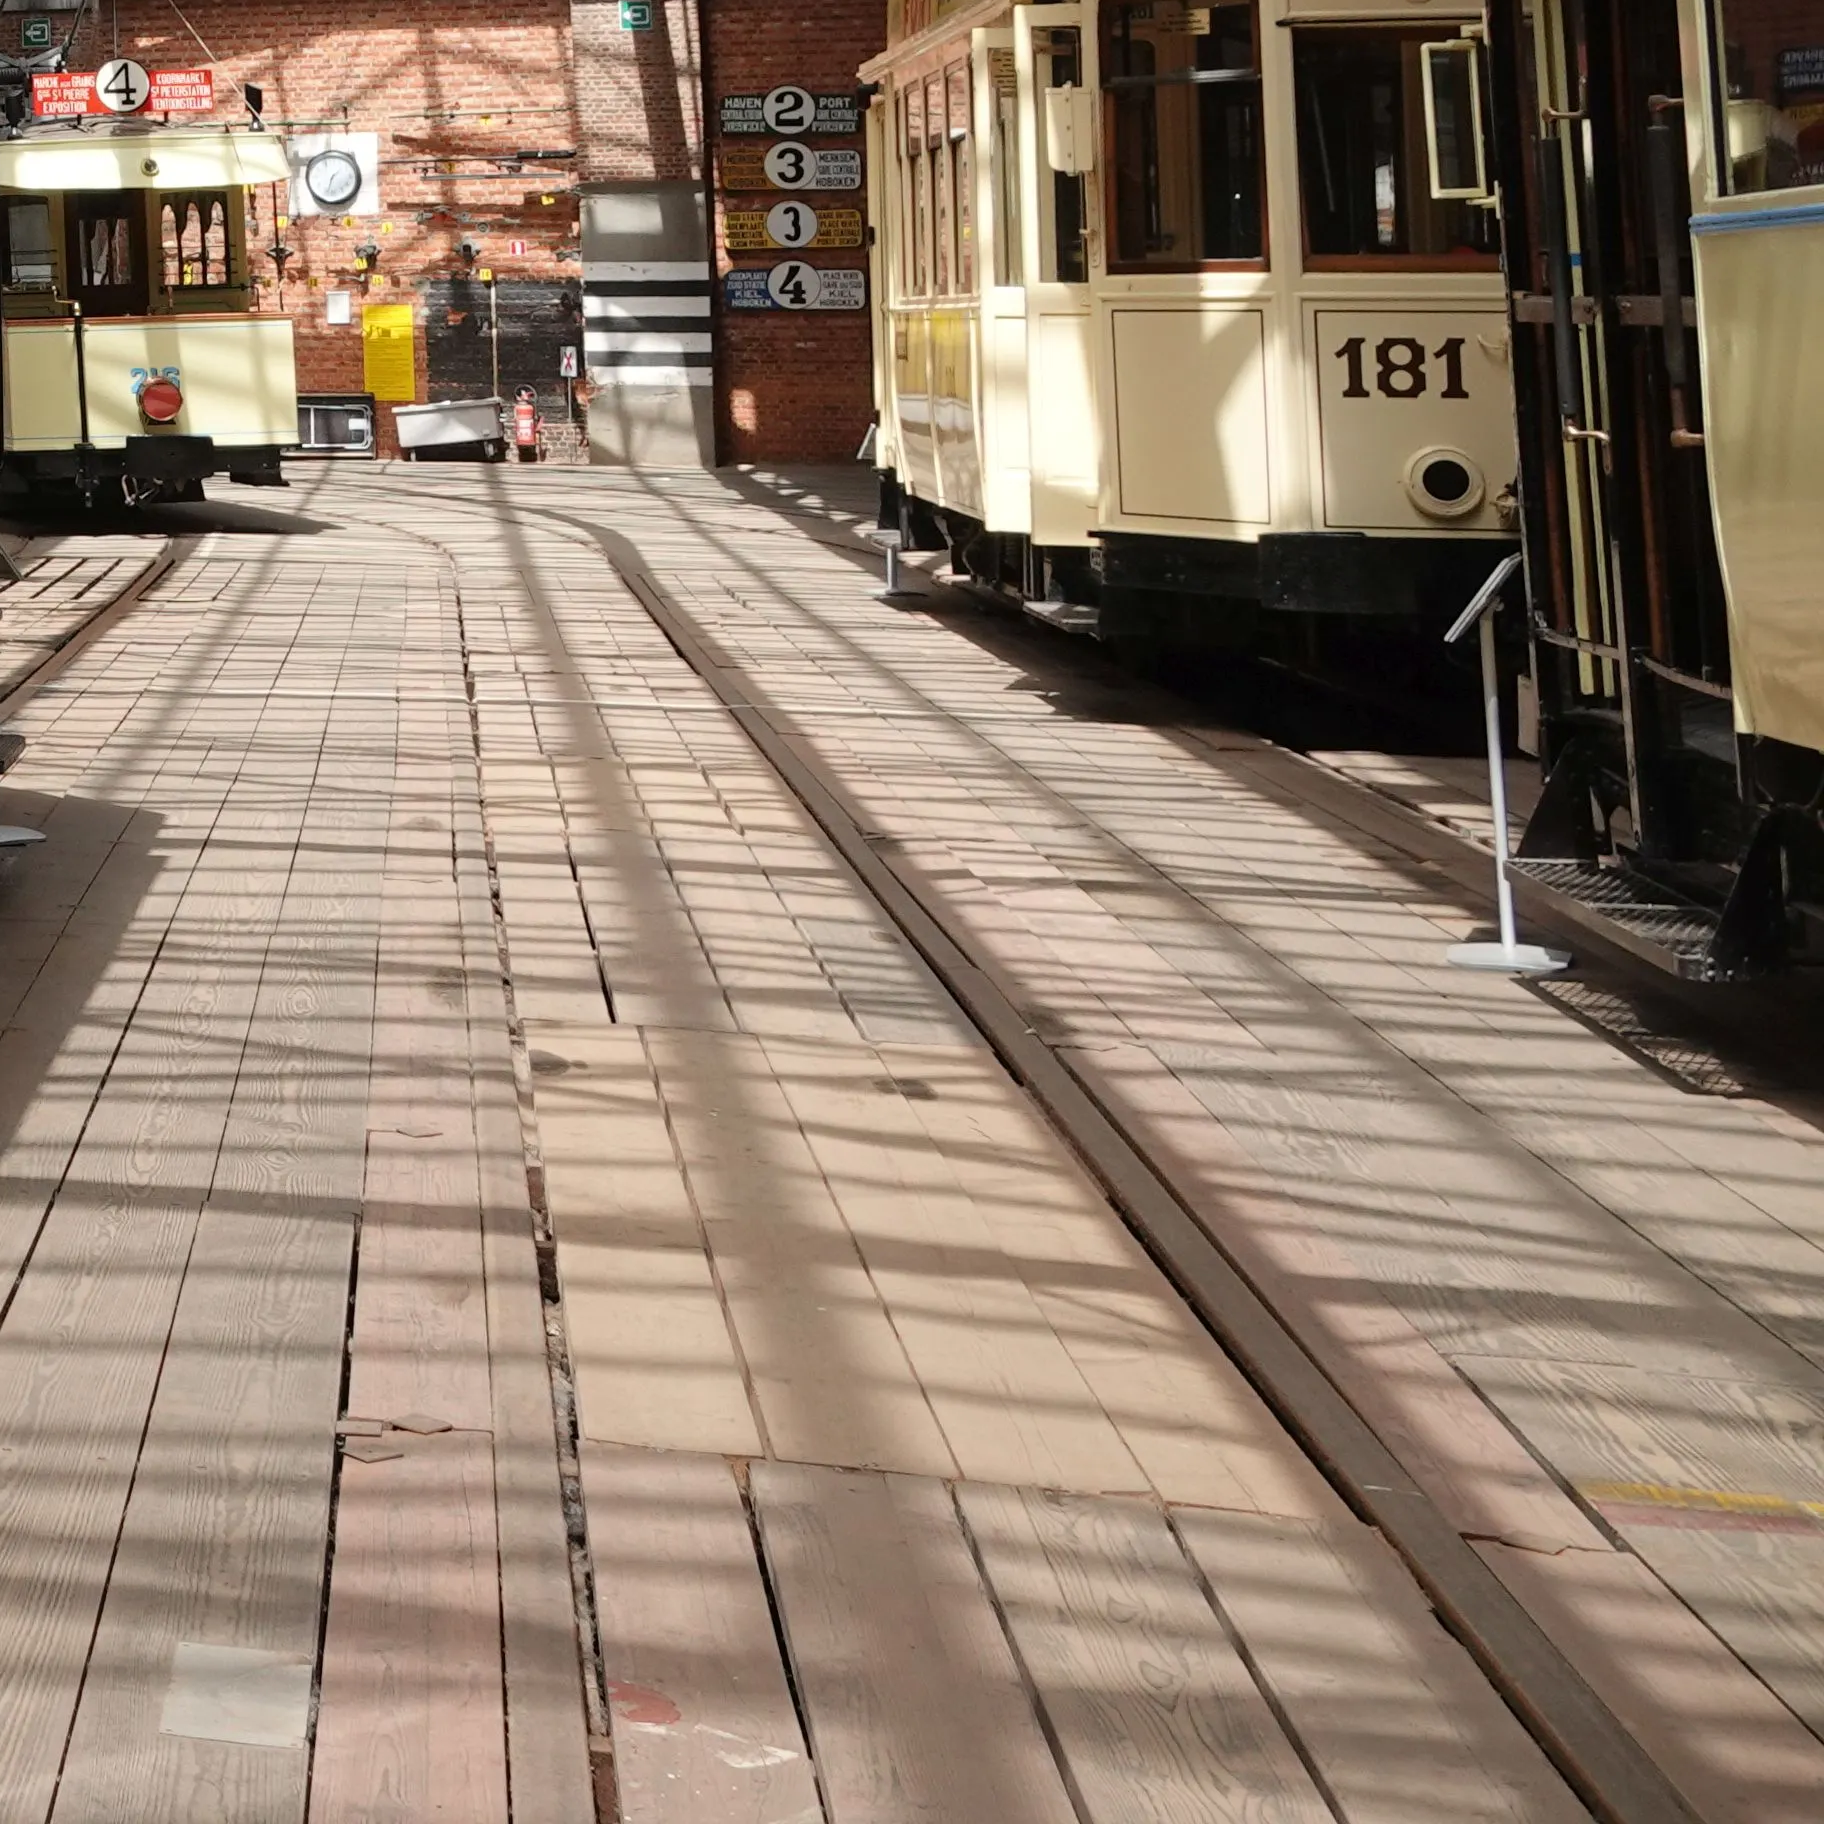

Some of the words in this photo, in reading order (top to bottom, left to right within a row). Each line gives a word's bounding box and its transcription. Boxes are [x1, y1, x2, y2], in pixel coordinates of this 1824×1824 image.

[104, 62, 136, 105] 4
[43, 101, 87, 114] EXPOSITION
[724, 97, 762, 108] HAVEN
[774, 91, 804, 126] 2
[820, 96, 852, 108] PORT
[776, 148, 805, 184] 3
[816, 177, 856, 187] HOBOKEN
[782, 206, 801, 242] 3
[735, 290, 762, 298] KIEL
[778, 265, 806, 304] 4
[828, 290, 856, 298] KIEL
[1335, 336, 1469, 398] 181
